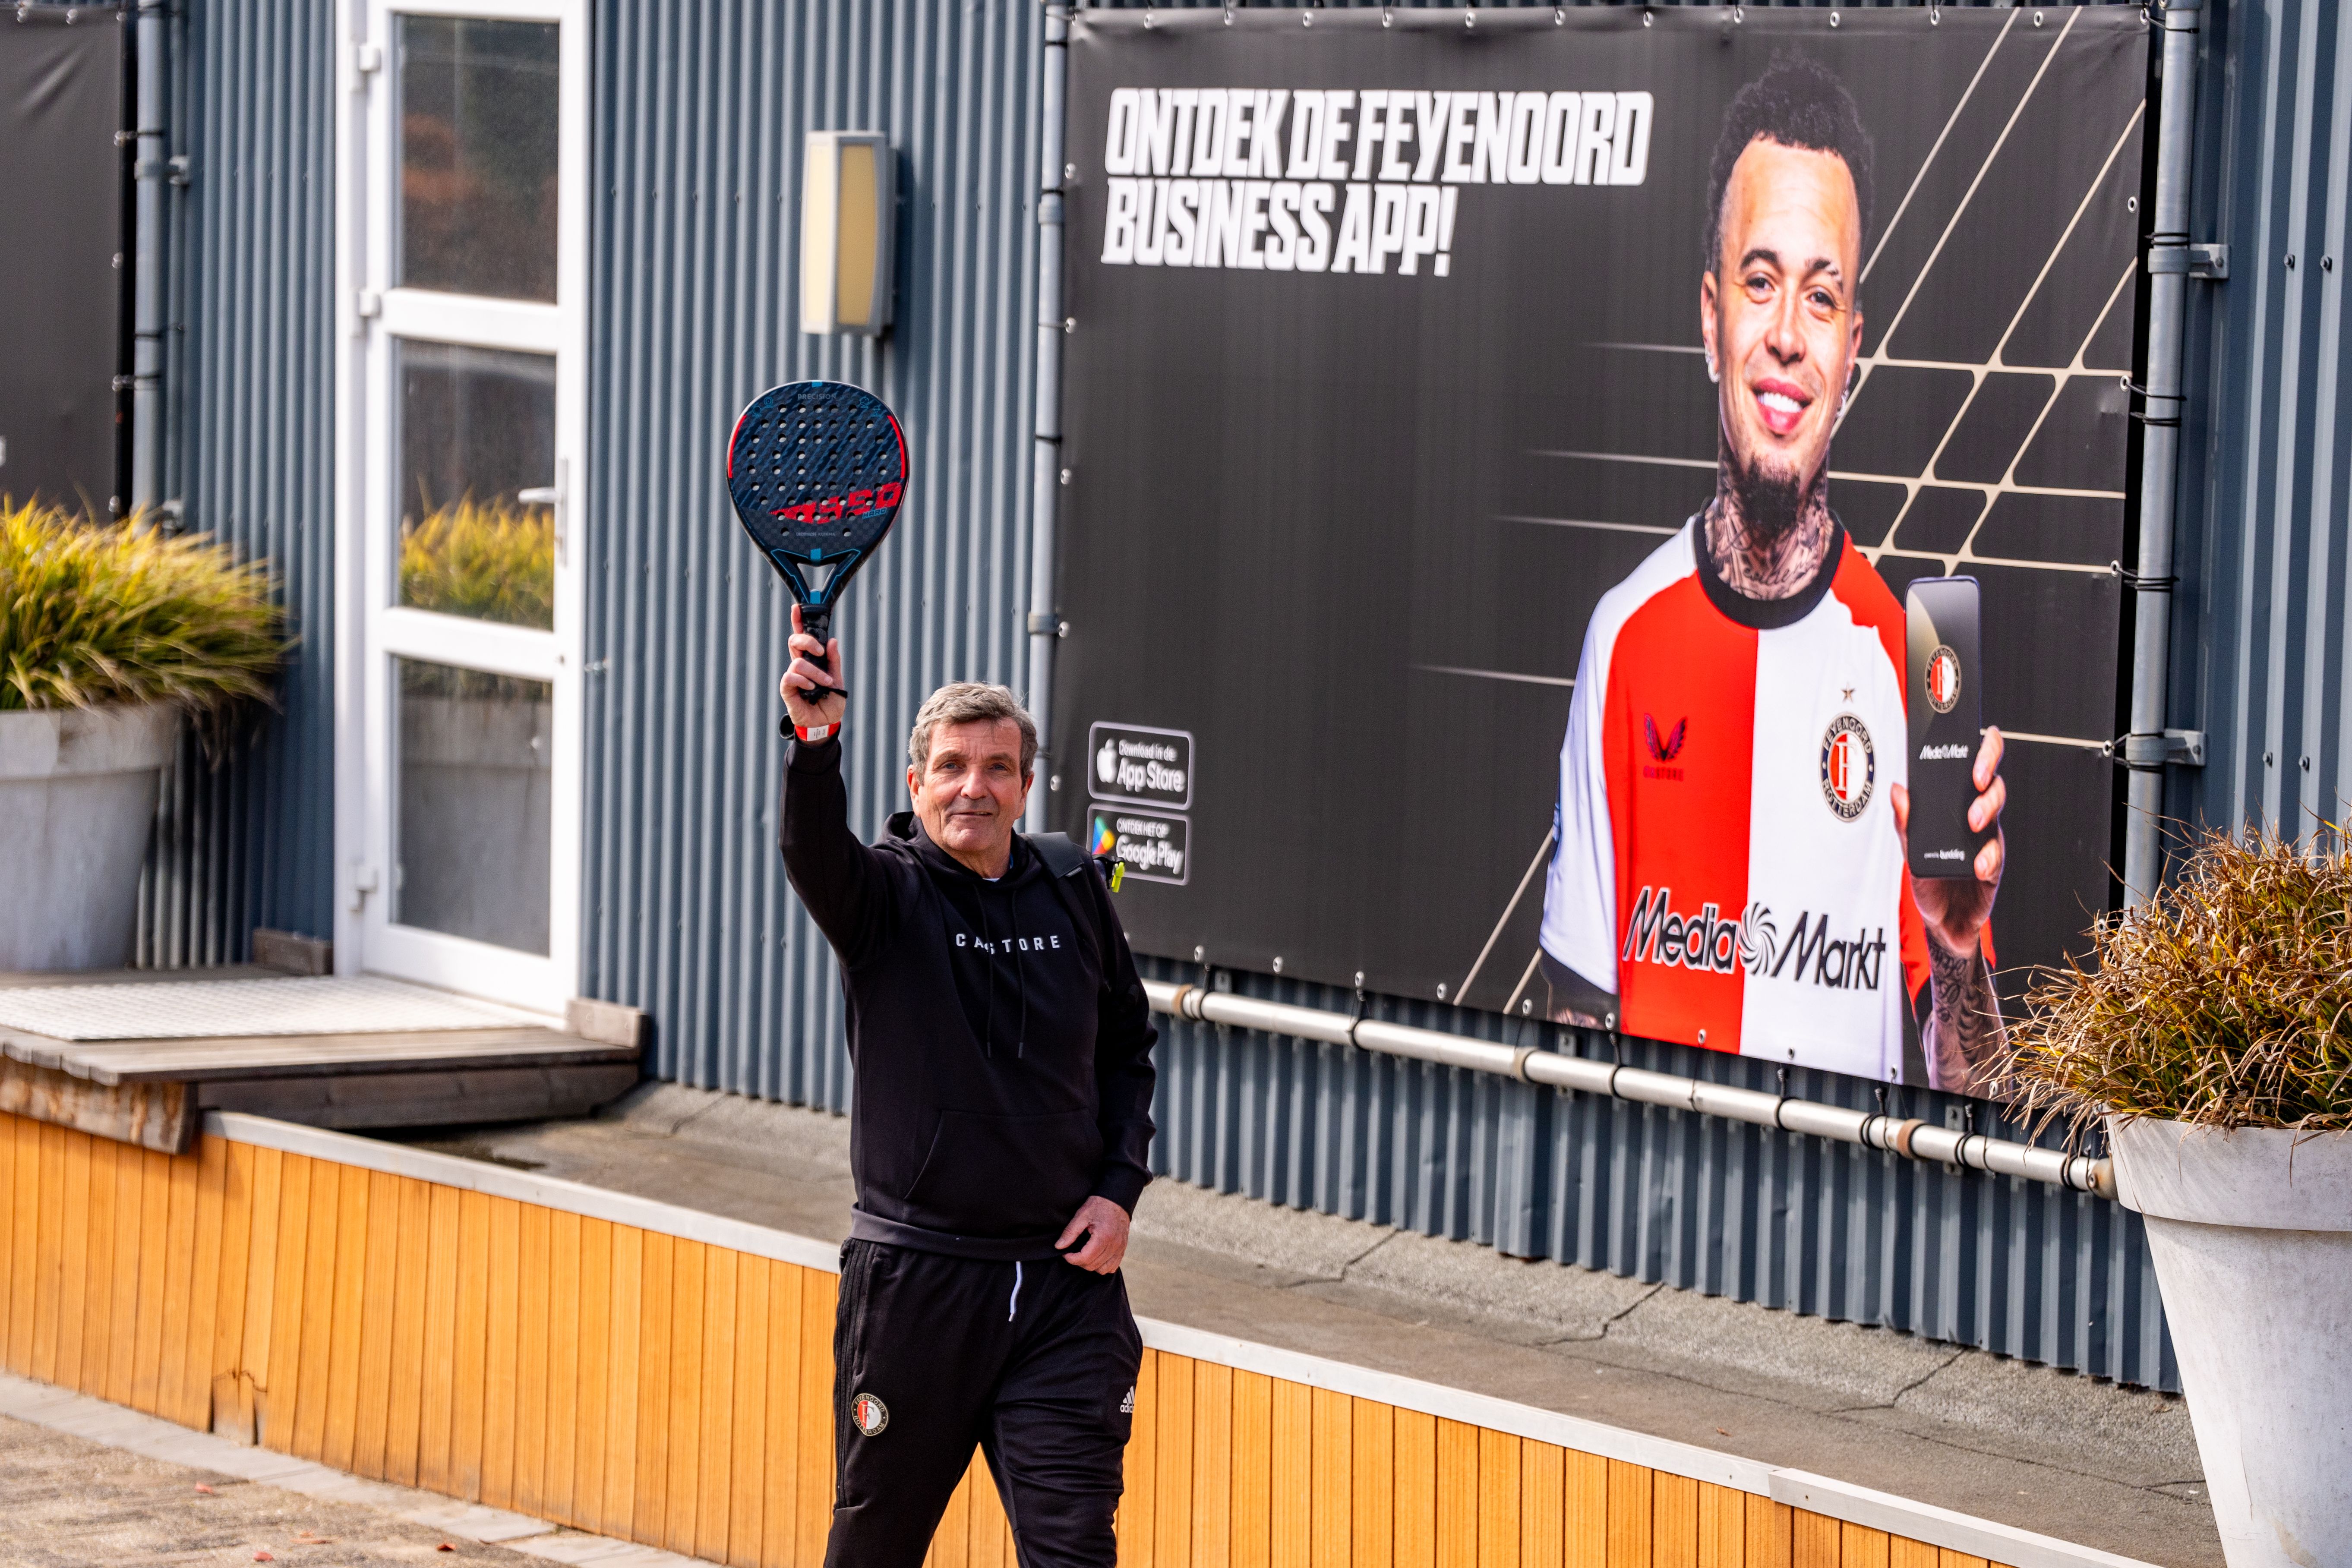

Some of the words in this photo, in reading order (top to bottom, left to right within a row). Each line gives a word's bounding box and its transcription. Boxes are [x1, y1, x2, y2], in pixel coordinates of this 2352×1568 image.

[1105, 88, 1290, 177] ONTDEK
[1286, 90, 1356, 180] DE
[1352, 89, 1654, 186] FEYENOORD
[1101, 177, 1335, 272] BUSINESS
[1330, 183, 1459, 277] APP!
[1119, 739, 1155, 759] Download
[1155, 743, 1164, 760] in
[1164, 745, 1178, 762] de
[1822, 716, 1873, 754] FEYENOORD
[1117, 757, 1147, 792] App
[1146, 760, 1186, 792] Store
[1822, 777, 1872, 818] ROTTERDAM
[1116, 817, 1144, 836] ONTDEK
[1143, 821, 1158, 837] HET
[1156, 822, 1170, 838] OP
[1116, 834, 1157, 871] Google
[1157, 840, 1184, 874] Play
[854, 1394, 885, 1412] FEYENOORD
[1120, 1402, 1134, 1413] adid
[854, 1415, 885, 1435] ROTTERDAM
